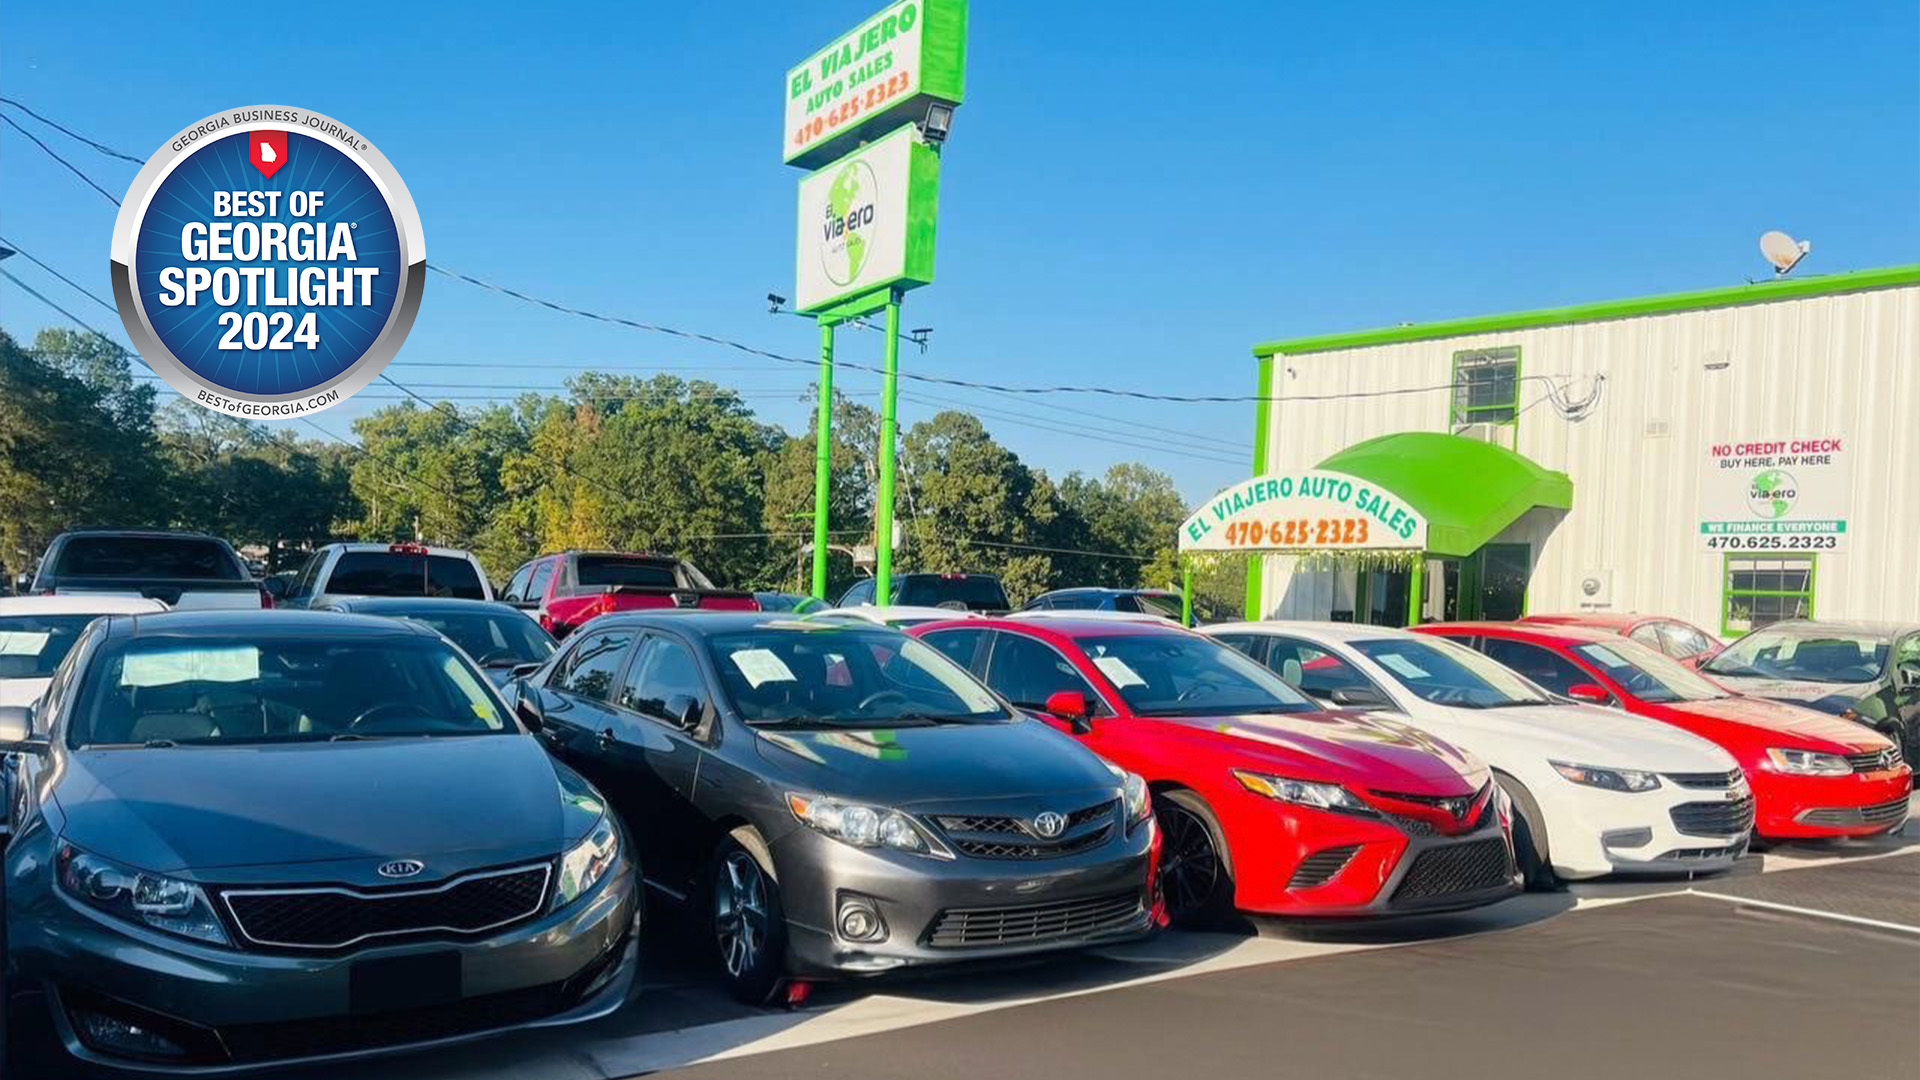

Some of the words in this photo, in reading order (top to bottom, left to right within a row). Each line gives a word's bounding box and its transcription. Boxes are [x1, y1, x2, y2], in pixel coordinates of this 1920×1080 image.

[791, 68, 813, 100] EL
[821, 3, 916, 79] VIAJERO
[805, 80, 843, 115] AUTO
[849, 50, 893, 89] SALES
[1712, 445, 1732, 457] NO
[1735, 442, 1786, 455] CREDIT
[1790, 440, 1842, 453] CHECK
[1720, 459, 1741, 468] BUY
[1778, 456, 1798, 466] PAY
[1801, 455, 1831, 465] HERE
[1187, 518, 1211, 542] EL
[1212, 477, 1293, 521] VIAJERO
[1298, 477, 1352, 502] AUTO
[1355, 488, 1417, 539] SALES
[1708, 523, 1724, 533] WE
[1728, 522, 1774, 533] FINANCE
[1777, 521, 1838, 533] EVERYONE
[1708, 536, 1837, 549] 470.625.2323
[386, 863, 415, 874] KIA
